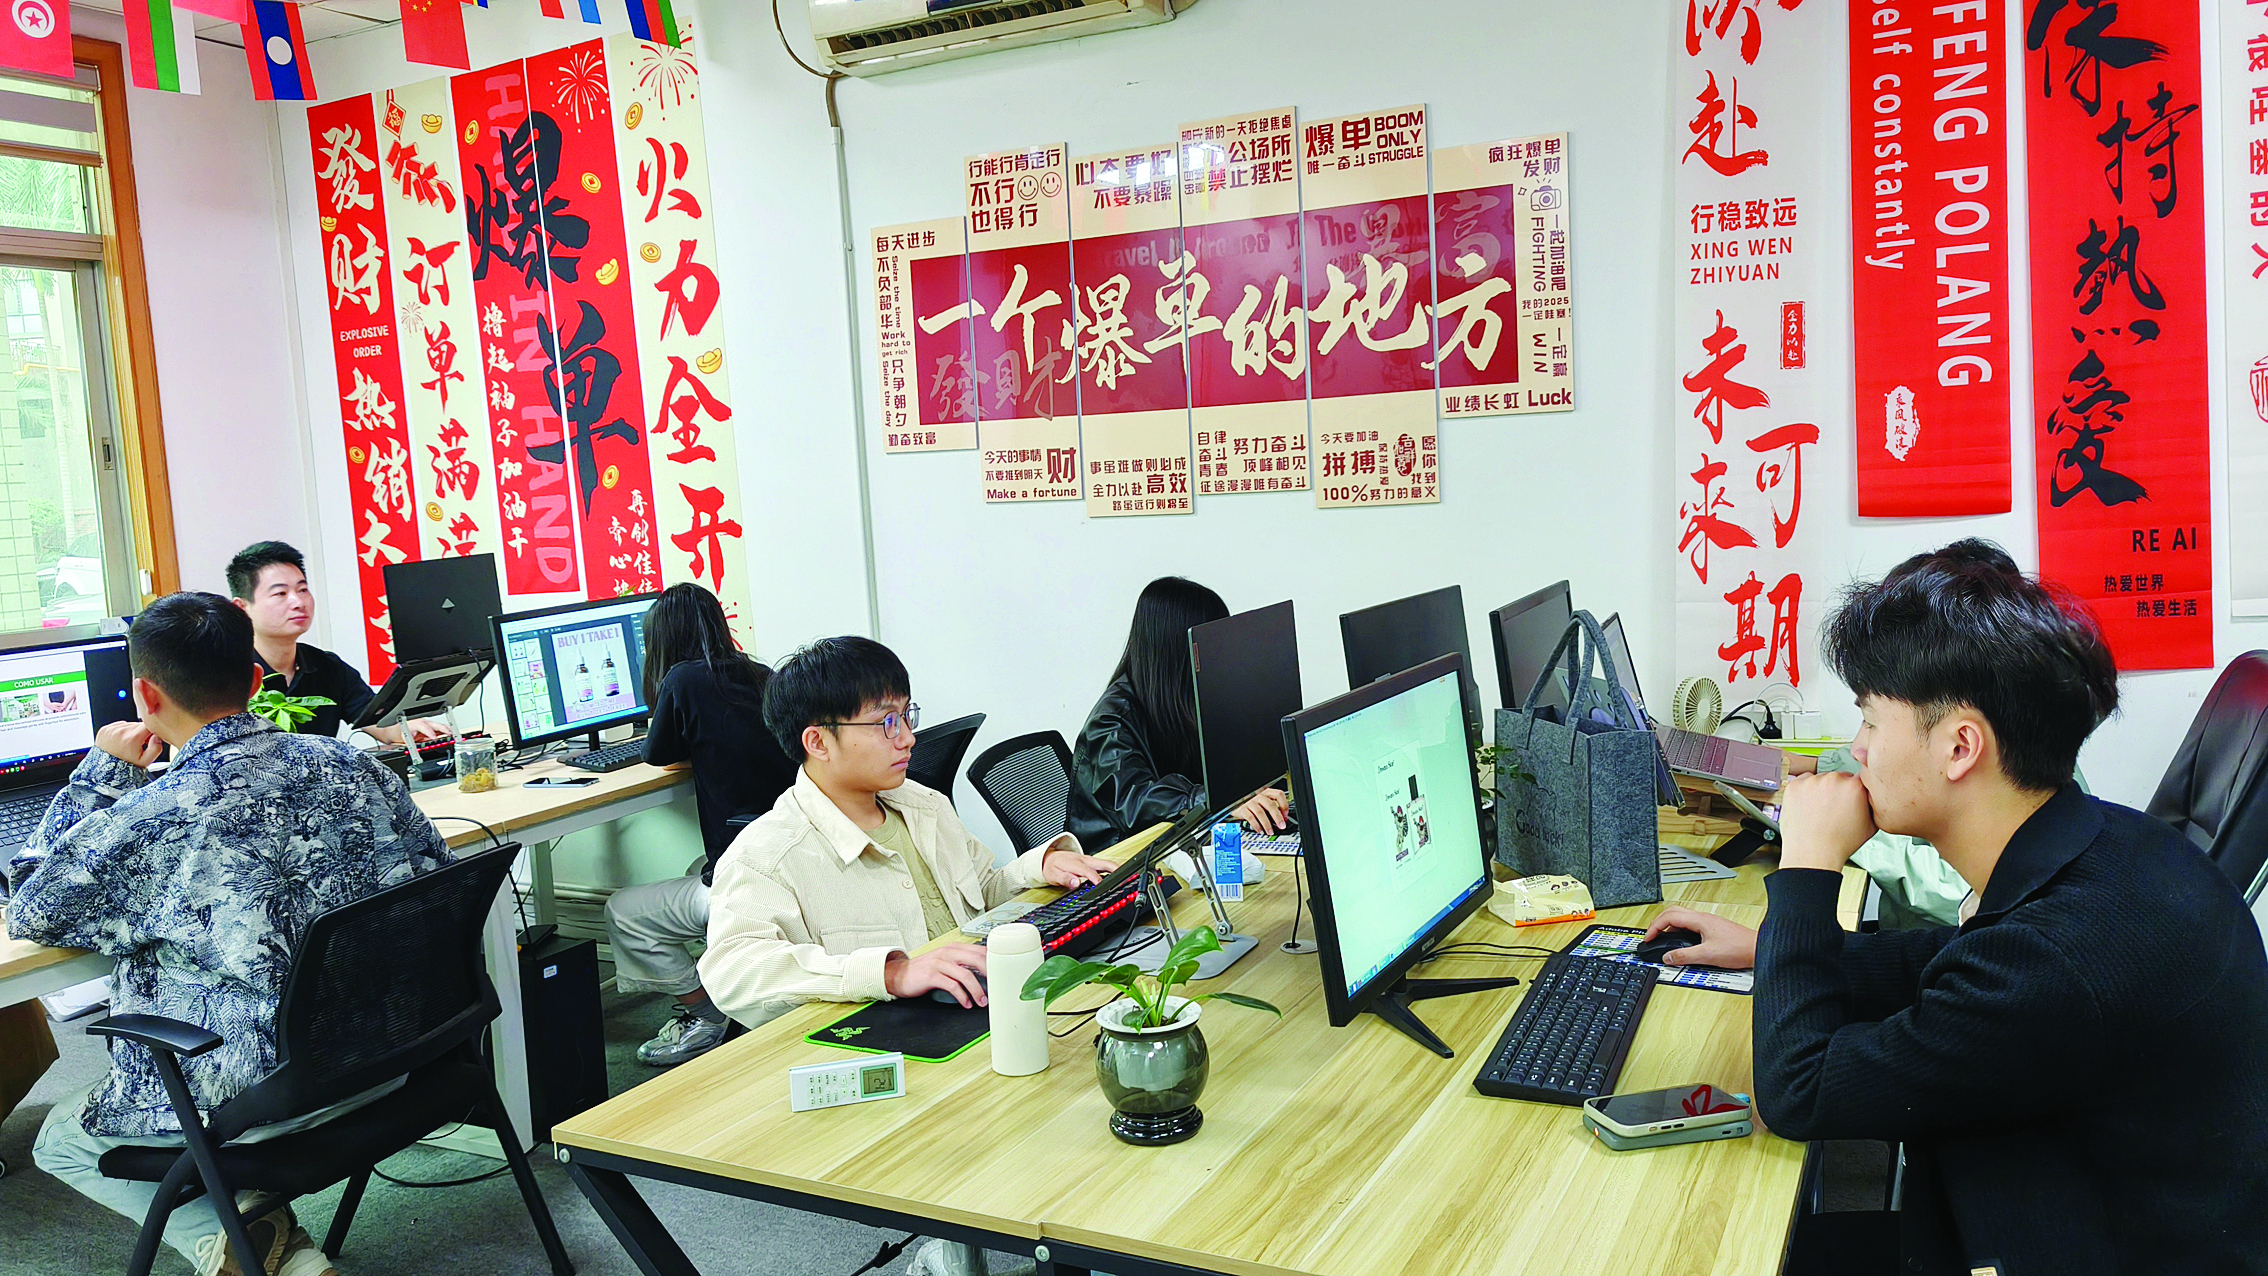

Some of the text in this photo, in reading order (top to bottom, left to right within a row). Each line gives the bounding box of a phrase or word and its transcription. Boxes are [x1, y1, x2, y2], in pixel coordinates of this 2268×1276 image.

[1374, 110, 1424, 132] BOOM
[1305, 116, 1371, 158] 爆单
[1376, 128, 1422, 149] ONLY
[1864, 0, 1916, 270] elf constantly
[1368, 145, 1424, 165] STRUGGLE
[1488, 138, 1561, 163] 疯狂爆单
[968, 148, 1061, 179] 行能行肯定行
[1307, 152, 1366, 175] 唯一奋斗
[1523, 156, 1561, 178] 发财
[1208, 159, 1293, 192] 禁止摆烂
[970, 177, 1015, 208] 不行
[971, 202, 1039, 234] 也得行
[1690, 197, 1798, 234] 行稳致远
[876, 230, 936, 253] 每天进步
[1690, 236, 1793, 261] XING WEN
[1530, 216, 1547, 293] FIGHTING
[1690, 262, 1780, 285] ZHIYUAN
[1934, 165, 1993, 387] POLANG
[876, 256, 894, 330] 不负韶华
[1521, 297, 1570, 310] 我的2025
[465, 110, 639, 522] 爆单
[339, 325, 390, 342] EXPLOSIVE
[881, 331, 906, 340] Work
[352, 345, 382, 358] ORDER
[1532, 332, 1549, 374] WIN
[635, 137, 743, 596] 火力全开
[1445, 391, 1520, 414] 业绩长虹
[1527, 387, 1572, 408] Luck
[888, 431, 937, 447] 勤奋致富
[1197, 430, 1227, 446] 自律
[1233, 433, 1307, 455] 努力奋斗
[1320, 430, 1379, 445] 今天要加油
[984, 448, 1042, 464] 今天的事情
[1046, 446, 1077, 484] 财
[1199, 447, 1228, 462] 奋斗
[1243, 455, 1307, 473] 顶峰相见
[1322, 449, 1376, 478] 拼搏
[985, 468, 1044, 482] 不要推到明天
[1089, 456, 1187, 475] 事虽难做则必成
[1199, 462, 1228, 478] 青春
[1146, 472, 1188, 495] 高效
[1200, 475, 1307, 493] 征途漫漫唯有奋斗
[1411, 471, 1436, 485] 找到
[986, 487, 1078, 499] Make a fortune
[1093, 481, 1143, 498] 全力以赴
[1322, 483, 1368, 503] 100%
[1369, 486, 1436, 501] 努力的意义
[2132, 526, 2198, 552] RE AI
[2103, 573, 2165, 593] 热爱世界
[2136, 599, 2198, 618] 热爱生活
[557, 634, 578, 648] BUY
[586, 629, 614, 643] TAKE
[13, 677, 54, 688] COMO USAR
